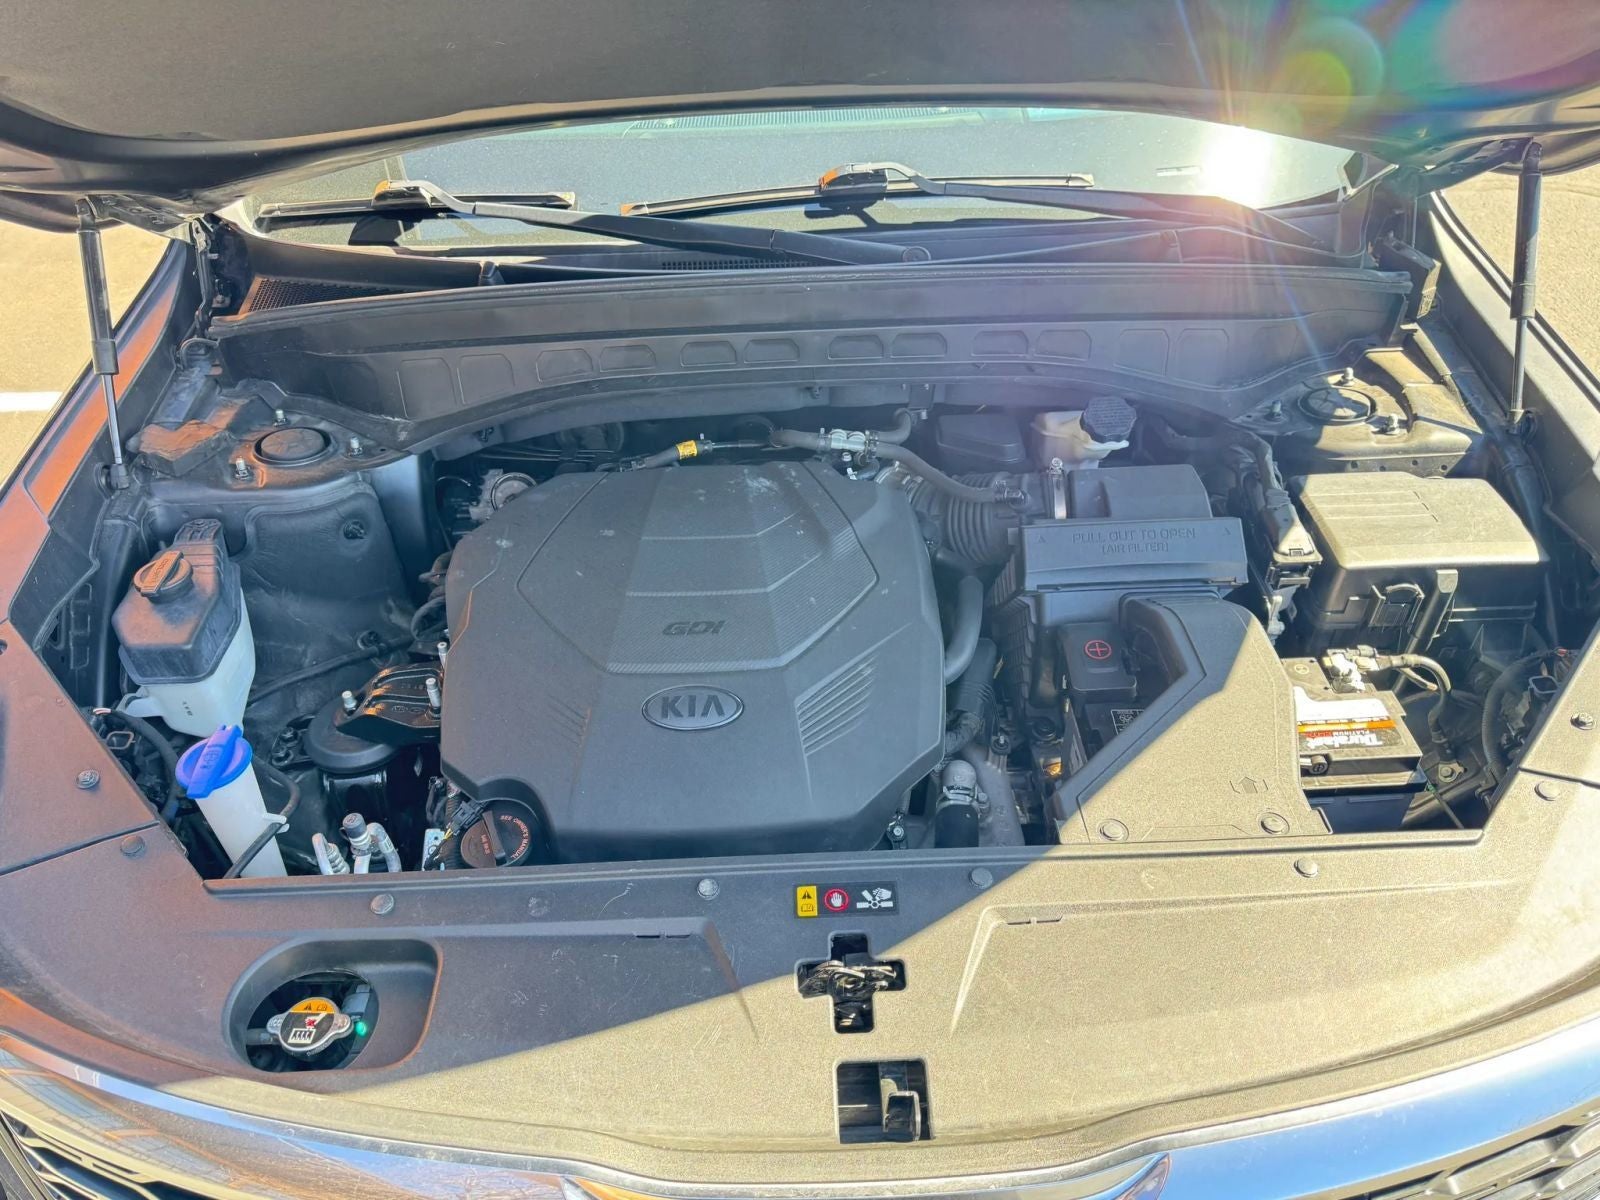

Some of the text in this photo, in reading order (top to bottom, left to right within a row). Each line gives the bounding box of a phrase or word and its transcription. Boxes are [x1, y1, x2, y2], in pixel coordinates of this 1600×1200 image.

[1072, 527, 1196, 544] PULL OUT TO OPEN
[662, 620, 726, 636] GDI
[661, 694, 725, 719] KIA
[510, 838, 529, 859] MANUAL
